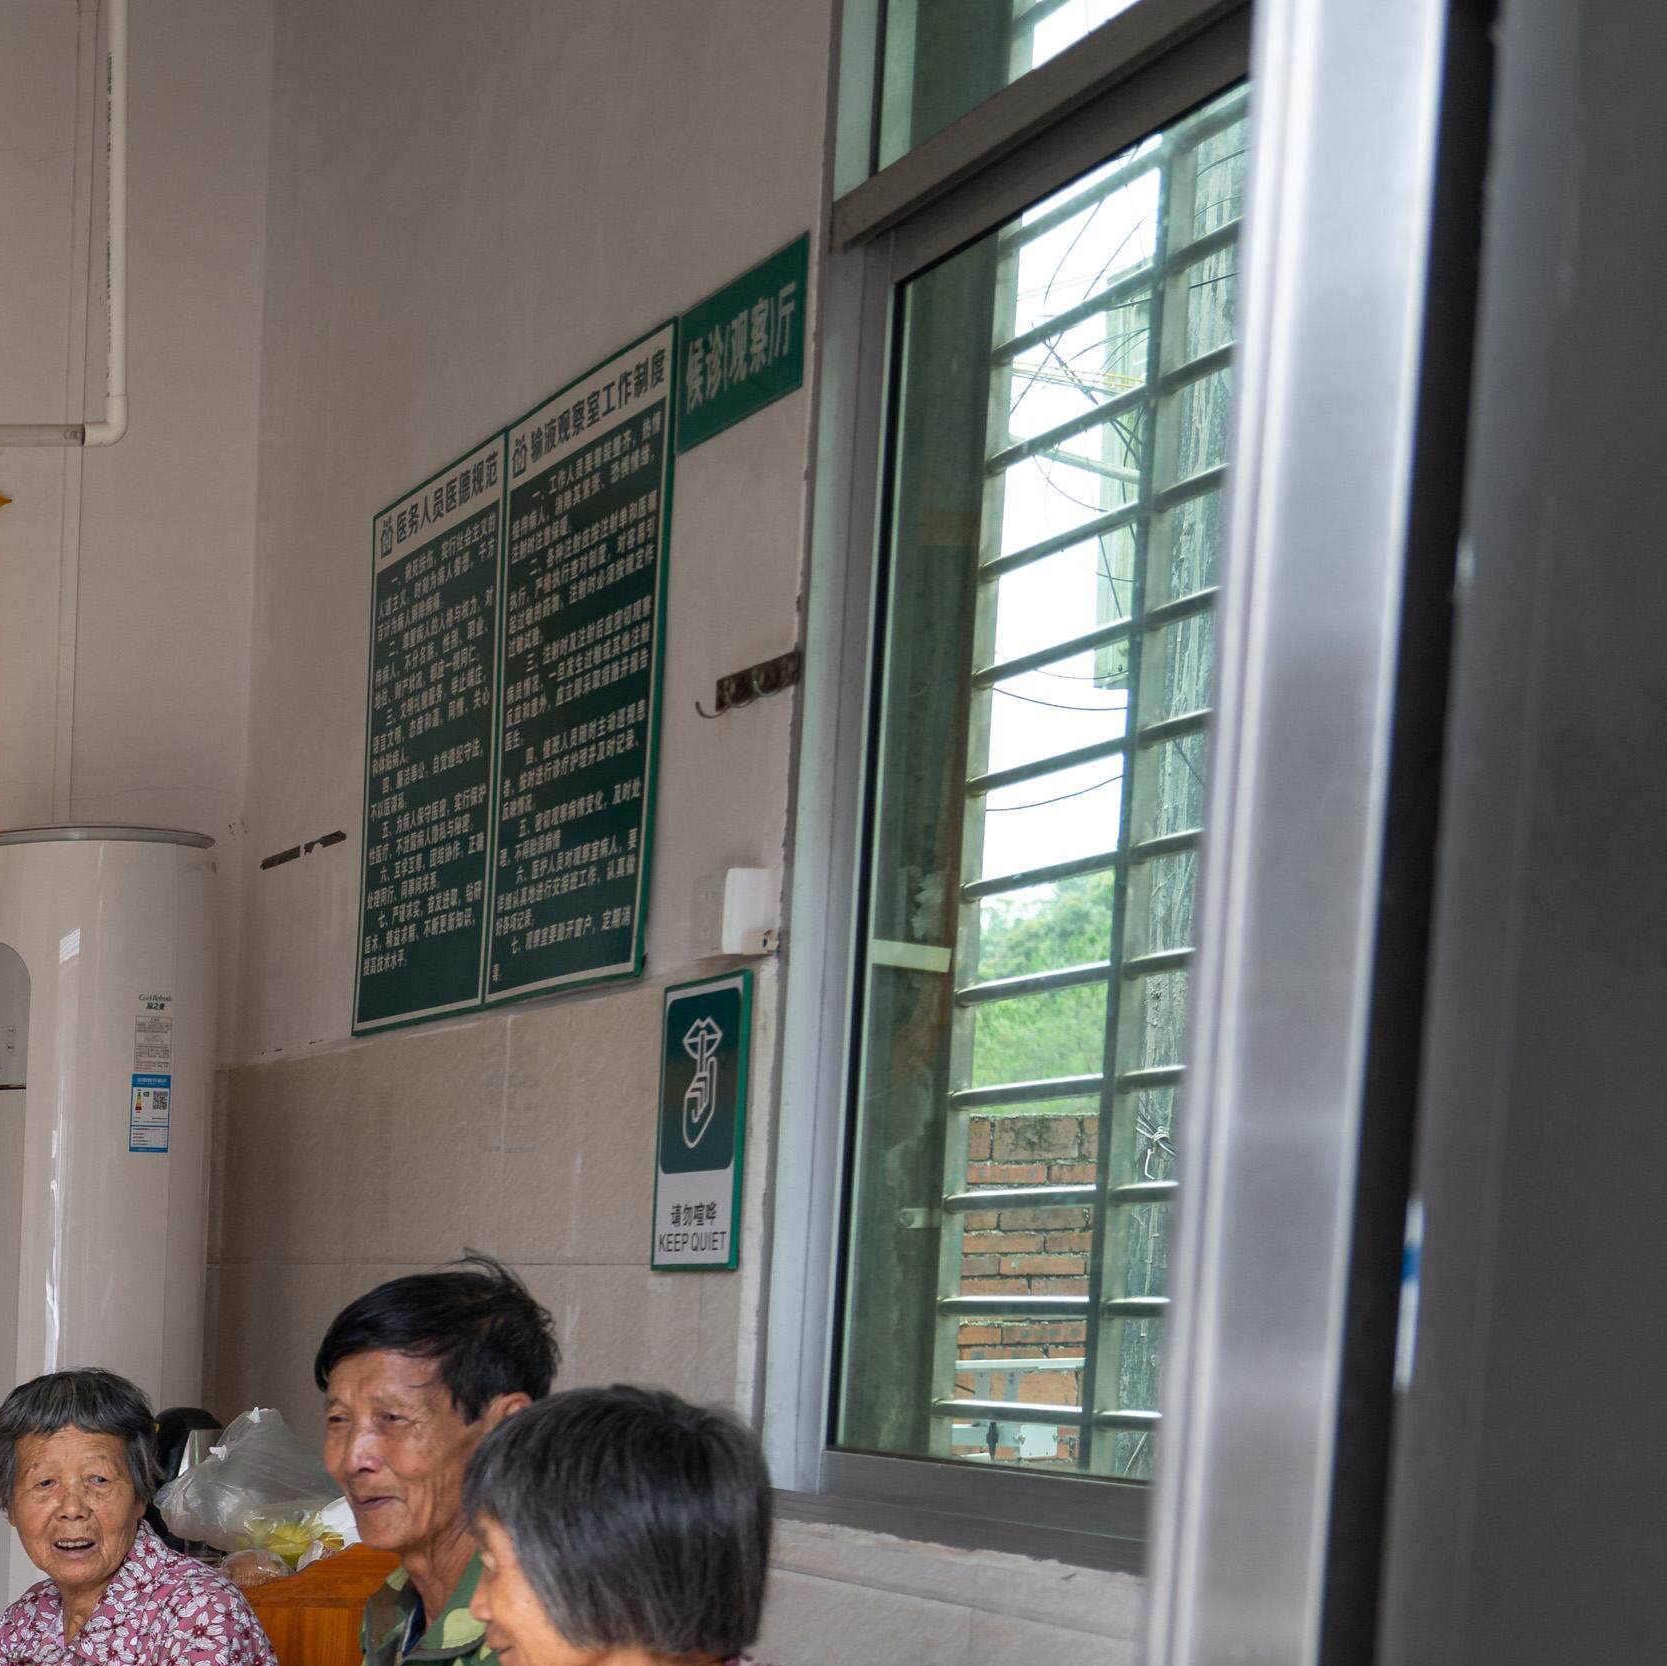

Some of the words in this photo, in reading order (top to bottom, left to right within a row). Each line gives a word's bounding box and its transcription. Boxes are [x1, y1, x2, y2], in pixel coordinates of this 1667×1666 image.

[530, 347, 667, 464] 输液观察室工作制度
[395, 452, 499, 544] 医务人员医德规范
[658, 1230, 690, 1254] KEEP
[691, 1230, 727, 1253] QUIET
[670, 1201, 717, 1229] 请勿喧哗
